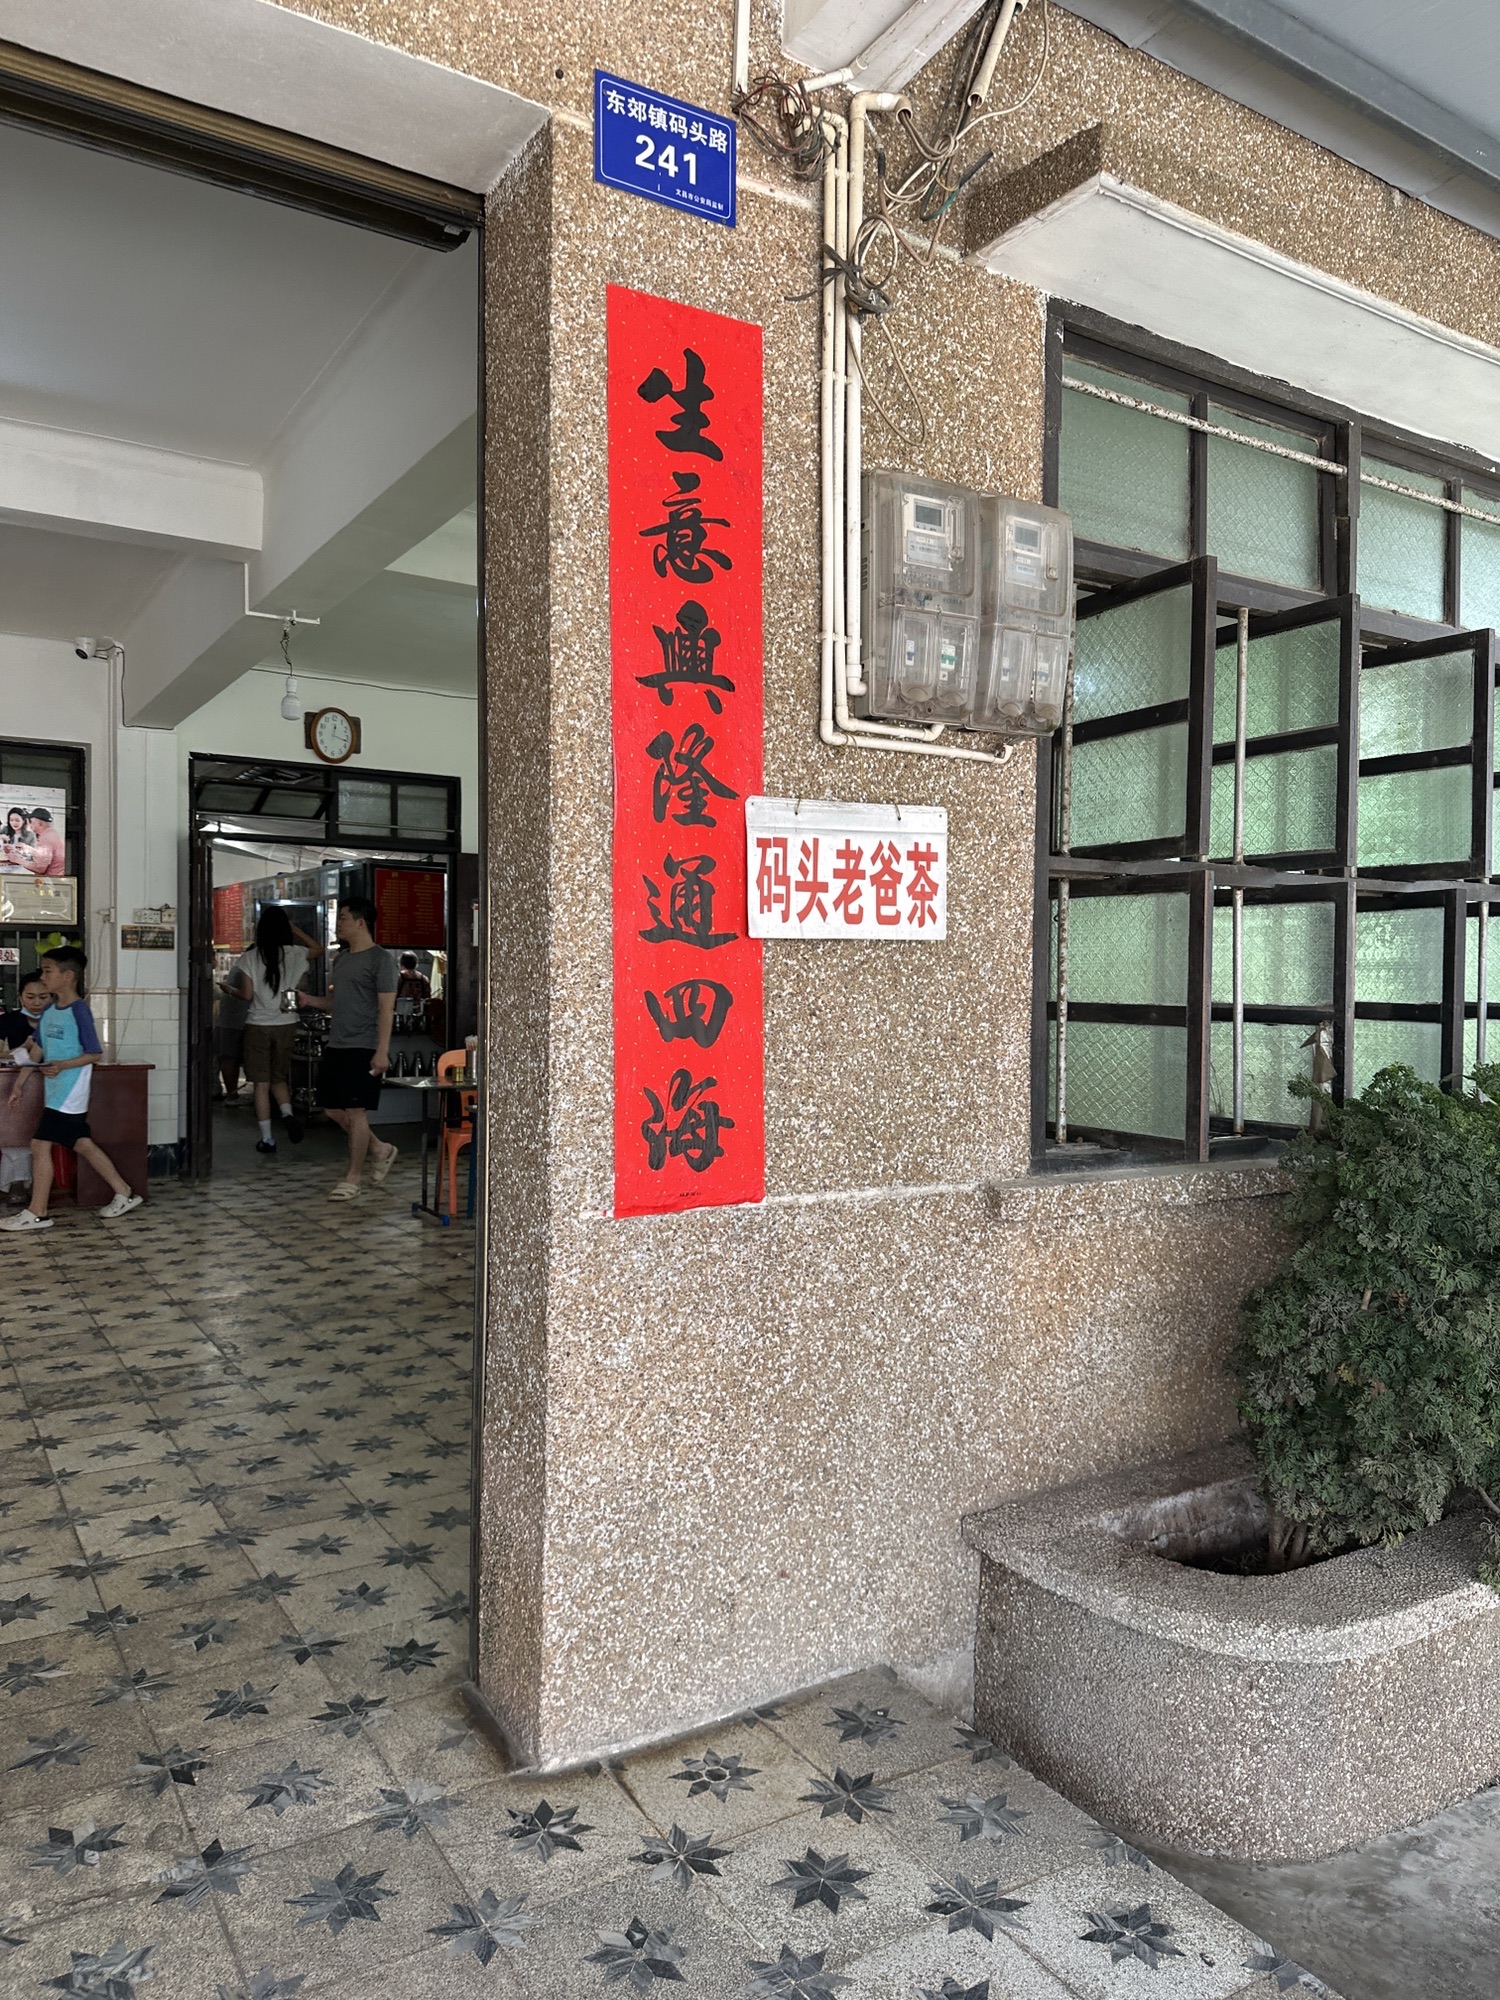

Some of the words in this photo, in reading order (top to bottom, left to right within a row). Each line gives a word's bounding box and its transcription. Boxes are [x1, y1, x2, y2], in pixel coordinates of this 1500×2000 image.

[606, 90, 728, 154] 东郊镇码头路
[635, 134, 697, 186] 241
[756, 837, 939, 928] 码头老爸茶
